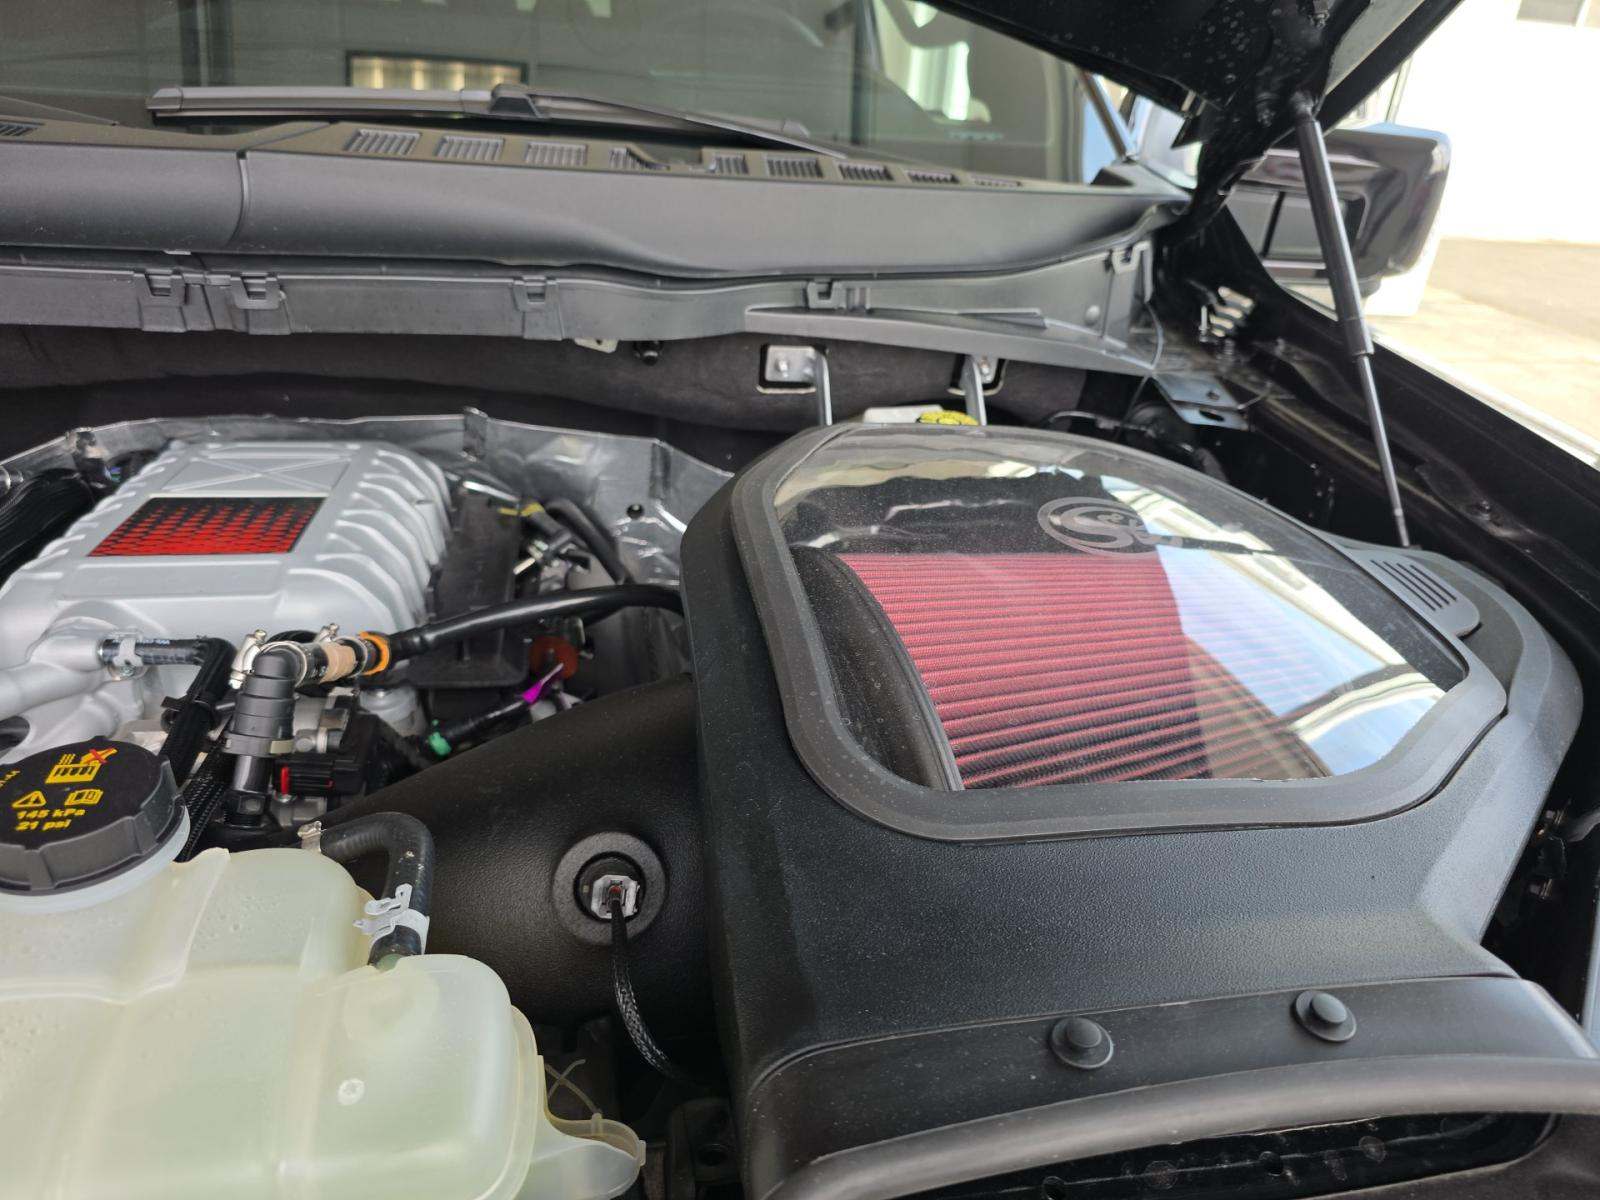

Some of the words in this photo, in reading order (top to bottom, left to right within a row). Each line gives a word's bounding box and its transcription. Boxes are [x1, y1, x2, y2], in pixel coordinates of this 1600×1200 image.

[52, 808, 86, 818] kPa
[16, 820, 39, 831] 21
[42, 819, 72, 831] psi
